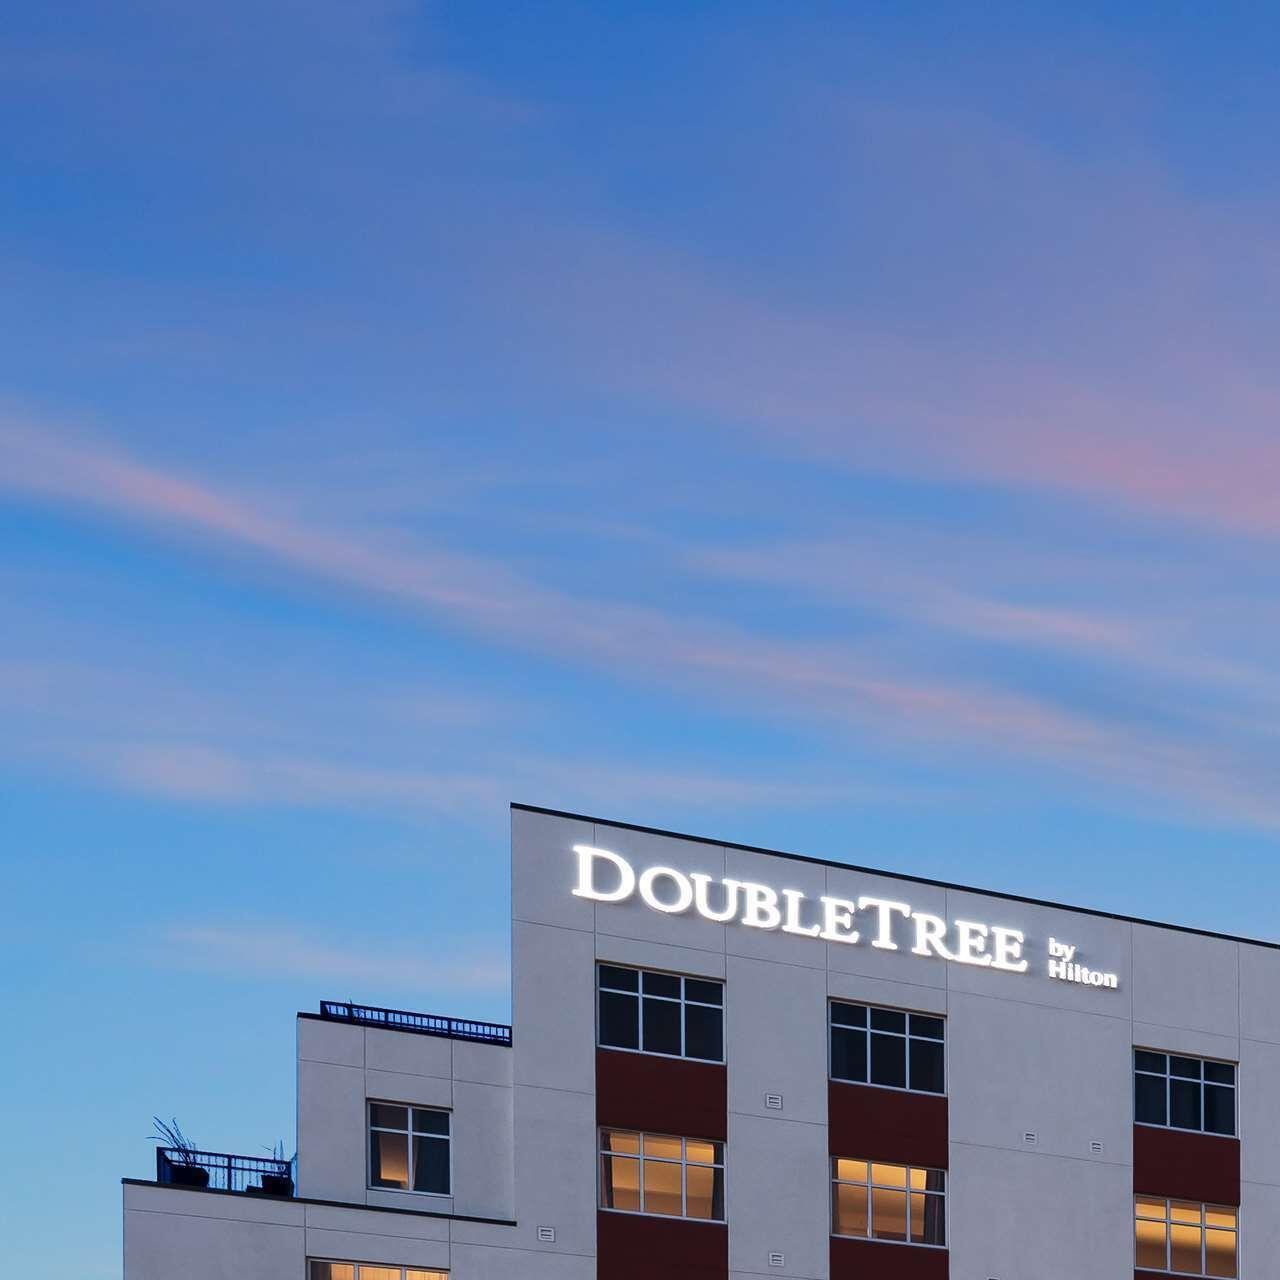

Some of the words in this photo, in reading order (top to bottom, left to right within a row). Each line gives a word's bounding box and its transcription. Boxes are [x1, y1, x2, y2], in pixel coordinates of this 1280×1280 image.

[571, 844, 1029, 973] DOUBLETREE
[1047, 936, 1076, 962] by
[1047, 958, 1119, 989] Hilton
